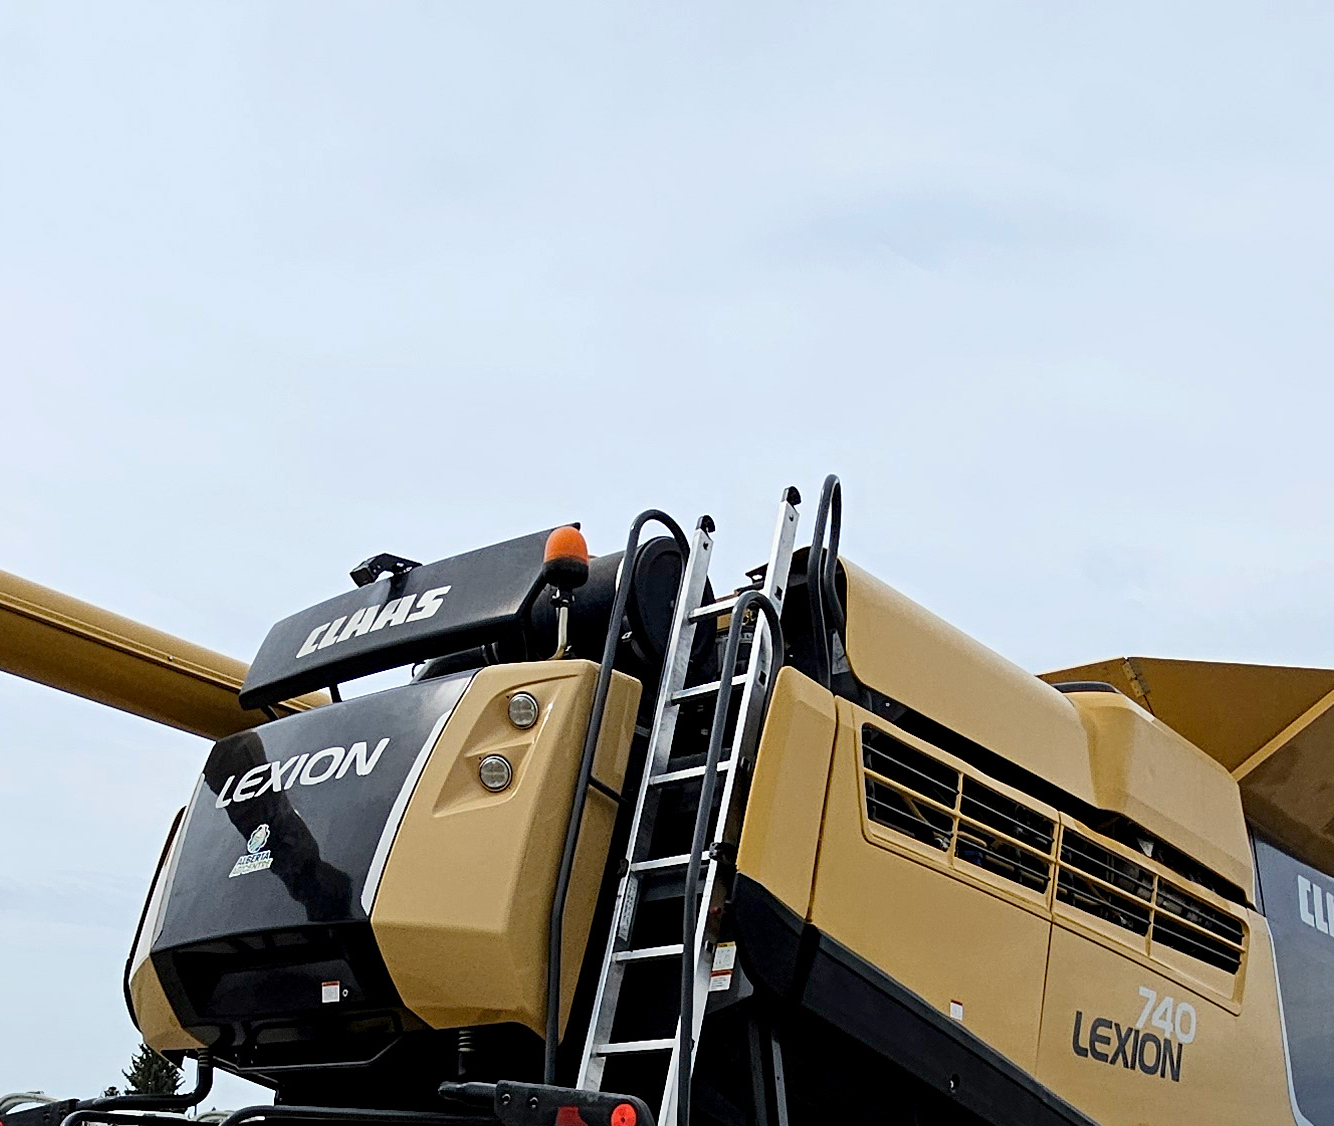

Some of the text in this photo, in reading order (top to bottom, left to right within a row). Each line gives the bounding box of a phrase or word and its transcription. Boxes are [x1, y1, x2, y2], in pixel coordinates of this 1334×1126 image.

[295, 585, 452, 658] CLAAS
[215, 737, 390, 808] LEXION
[1072, 1010, 1184, 1083] LEXION
[1136, 985, 1197, 1044] 740
